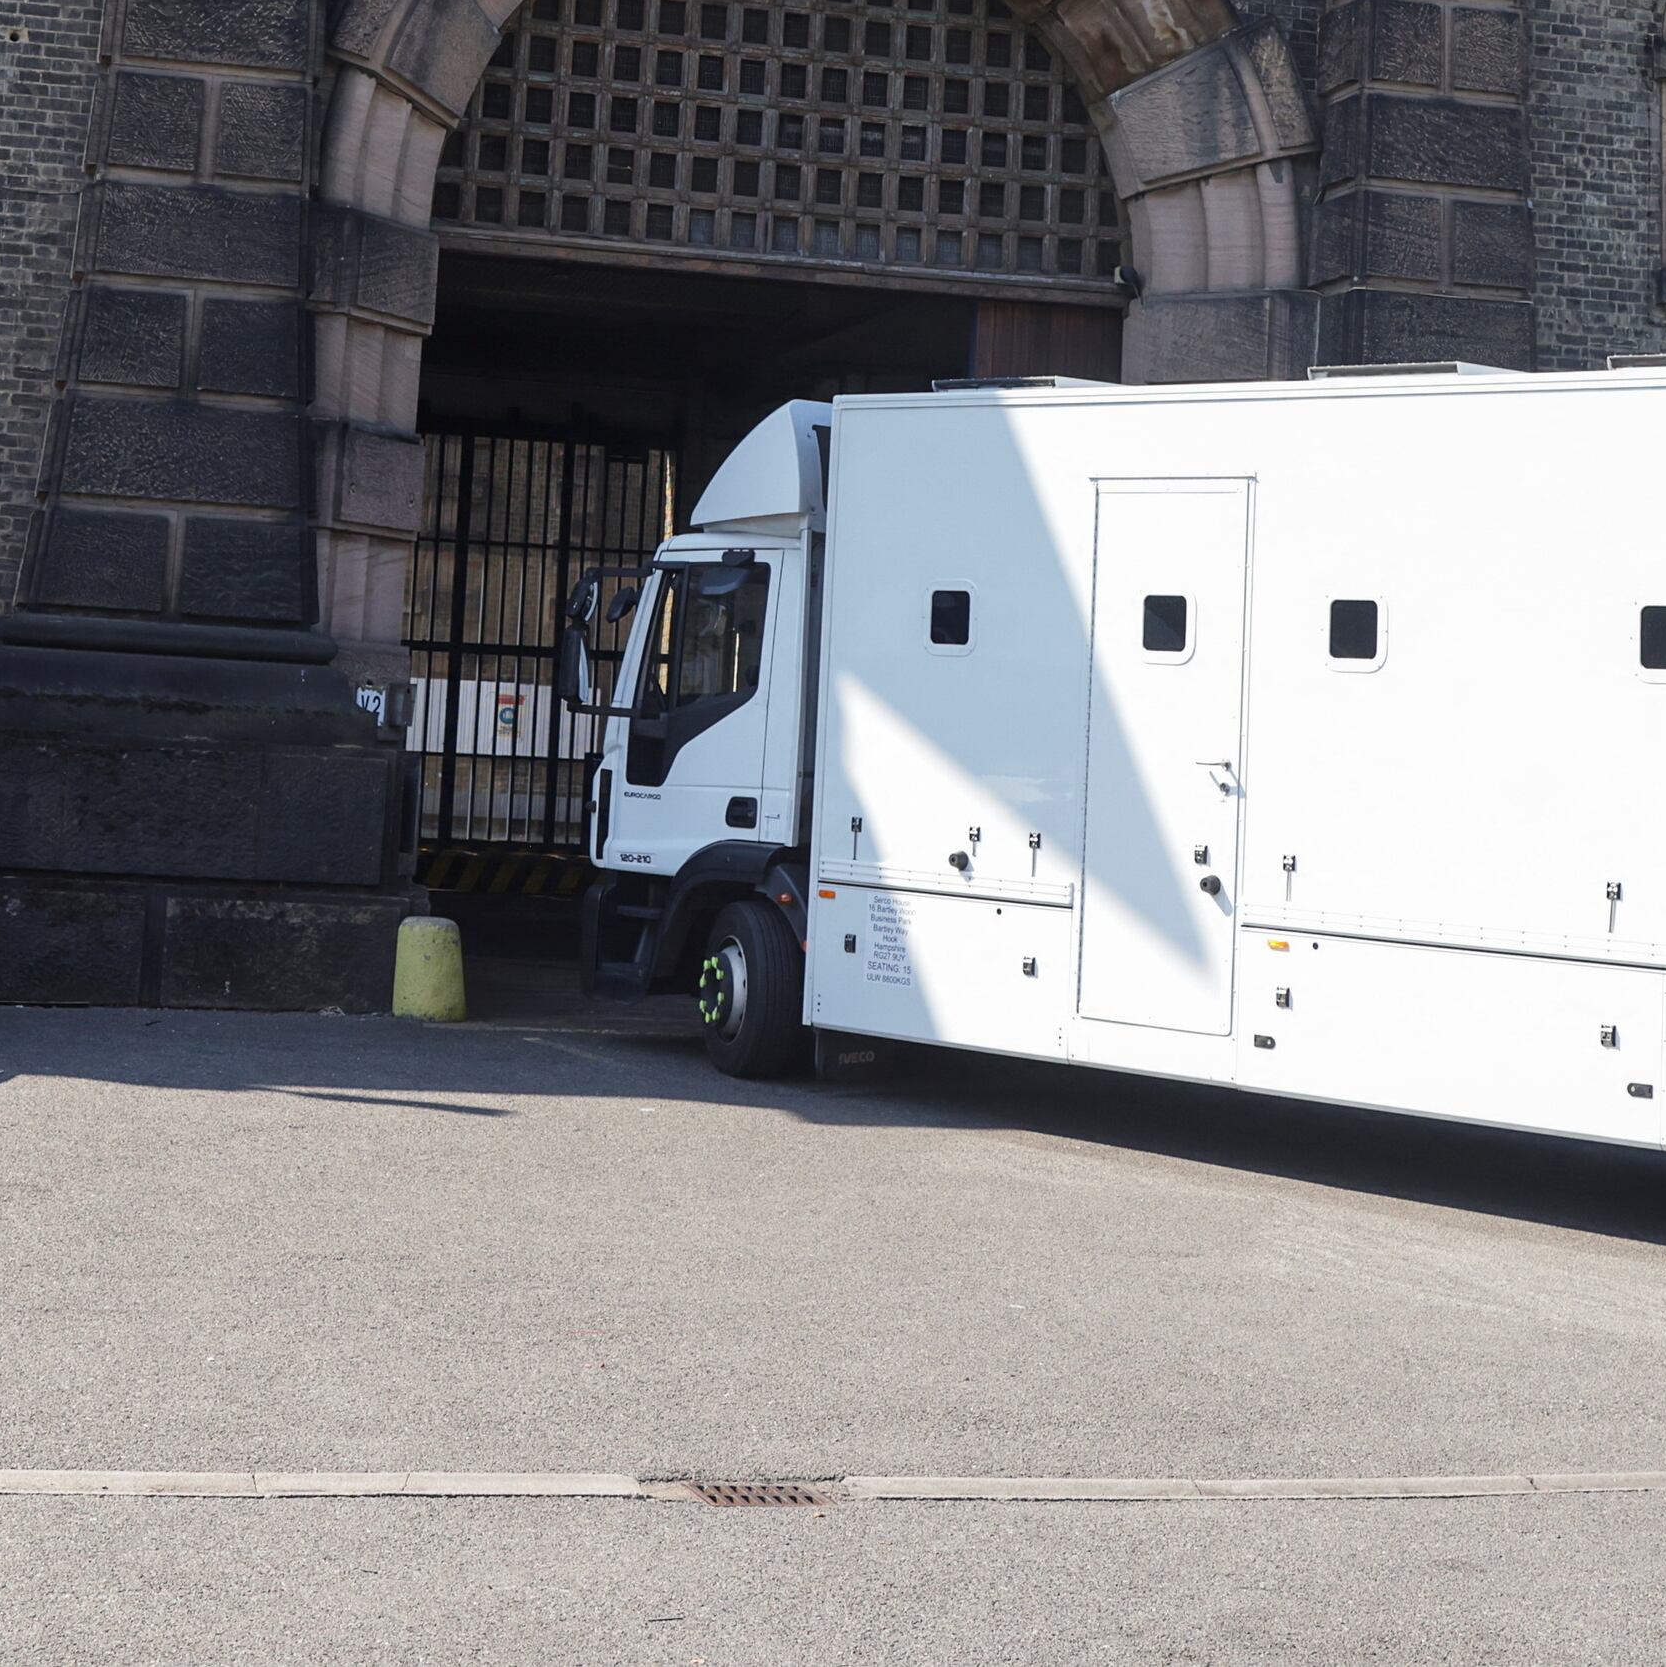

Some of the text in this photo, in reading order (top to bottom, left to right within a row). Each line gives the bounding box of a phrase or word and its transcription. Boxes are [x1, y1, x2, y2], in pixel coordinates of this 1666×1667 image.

[624, 791, 662, 800] EUROCARGO
[620, 853, 652, 864] 120-210
[874, 895, 891, 904] Serco
[877, 904, 897, 916] Bartley
[871, 913, 897, 923] Business
[873, 924, 908, 937] Bartley Way
[883, 934, 898, 942] Hook
[874, 942, 906, 953] Hampshire
[873, 951, 891, 960] RG27
[903, 965, 912, 975] 15
[866, 973, 881, 982] ULW
